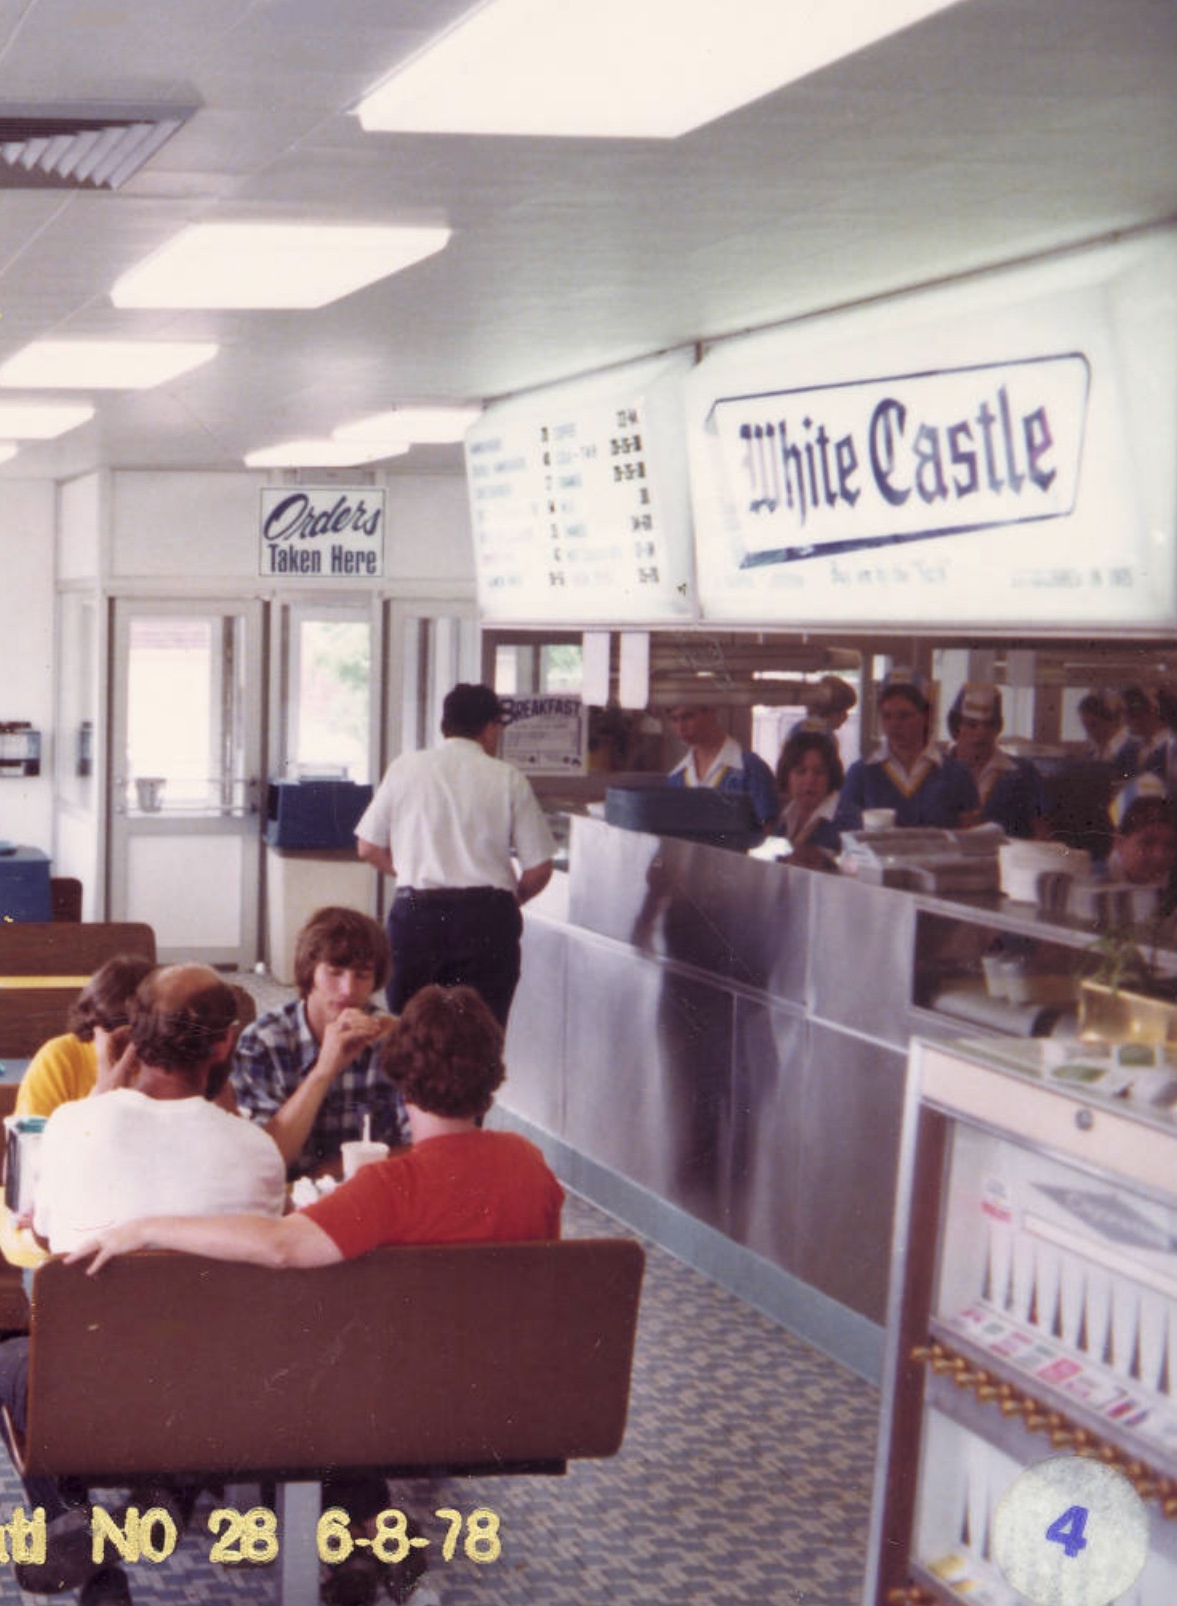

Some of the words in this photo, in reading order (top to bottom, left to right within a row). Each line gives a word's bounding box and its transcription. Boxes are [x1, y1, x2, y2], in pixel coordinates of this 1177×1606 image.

[739, 412, 861, 527] White
[869, 383, 1058, 506] Castle
[263, 492, 381, 541] Orders
[267, 543, 321, 573] Taken
[331, 544, 376, 574] Here
[497, 698, 581, 725] BREAKFAST
